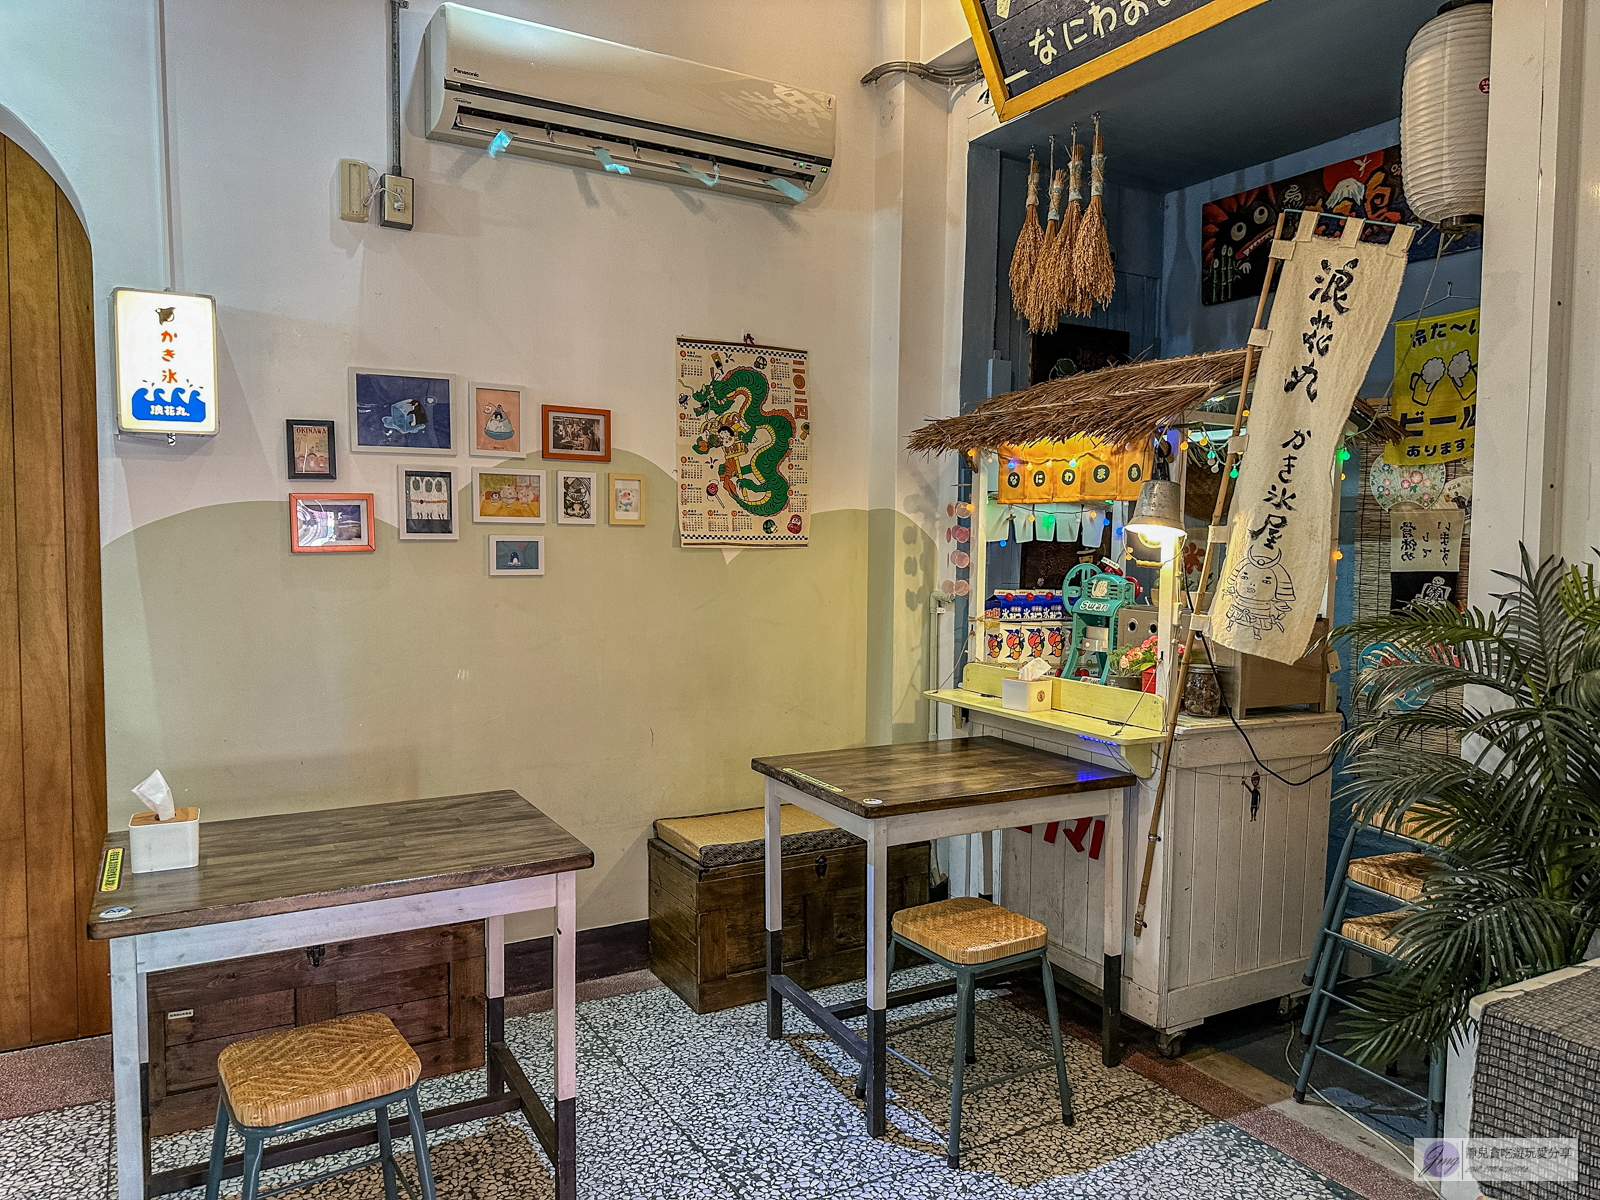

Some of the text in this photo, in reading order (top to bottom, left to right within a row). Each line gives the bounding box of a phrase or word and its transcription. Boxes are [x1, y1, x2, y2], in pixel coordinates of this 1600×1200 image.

[453, 67, 479, 77] Panasonic
[1284, 258, 1359, 402] 浪花丸
[161, 330, 178, 383] かき氷
[150, 404, 190, 417] 浪花丸
[296, 427, 327, 435] OKINAWA
[1009, 465, 1140, 488] なにわまる
[1248, 428, 1312, 550] かき氷屋
[1079, 600, 1111, 612] Swan
